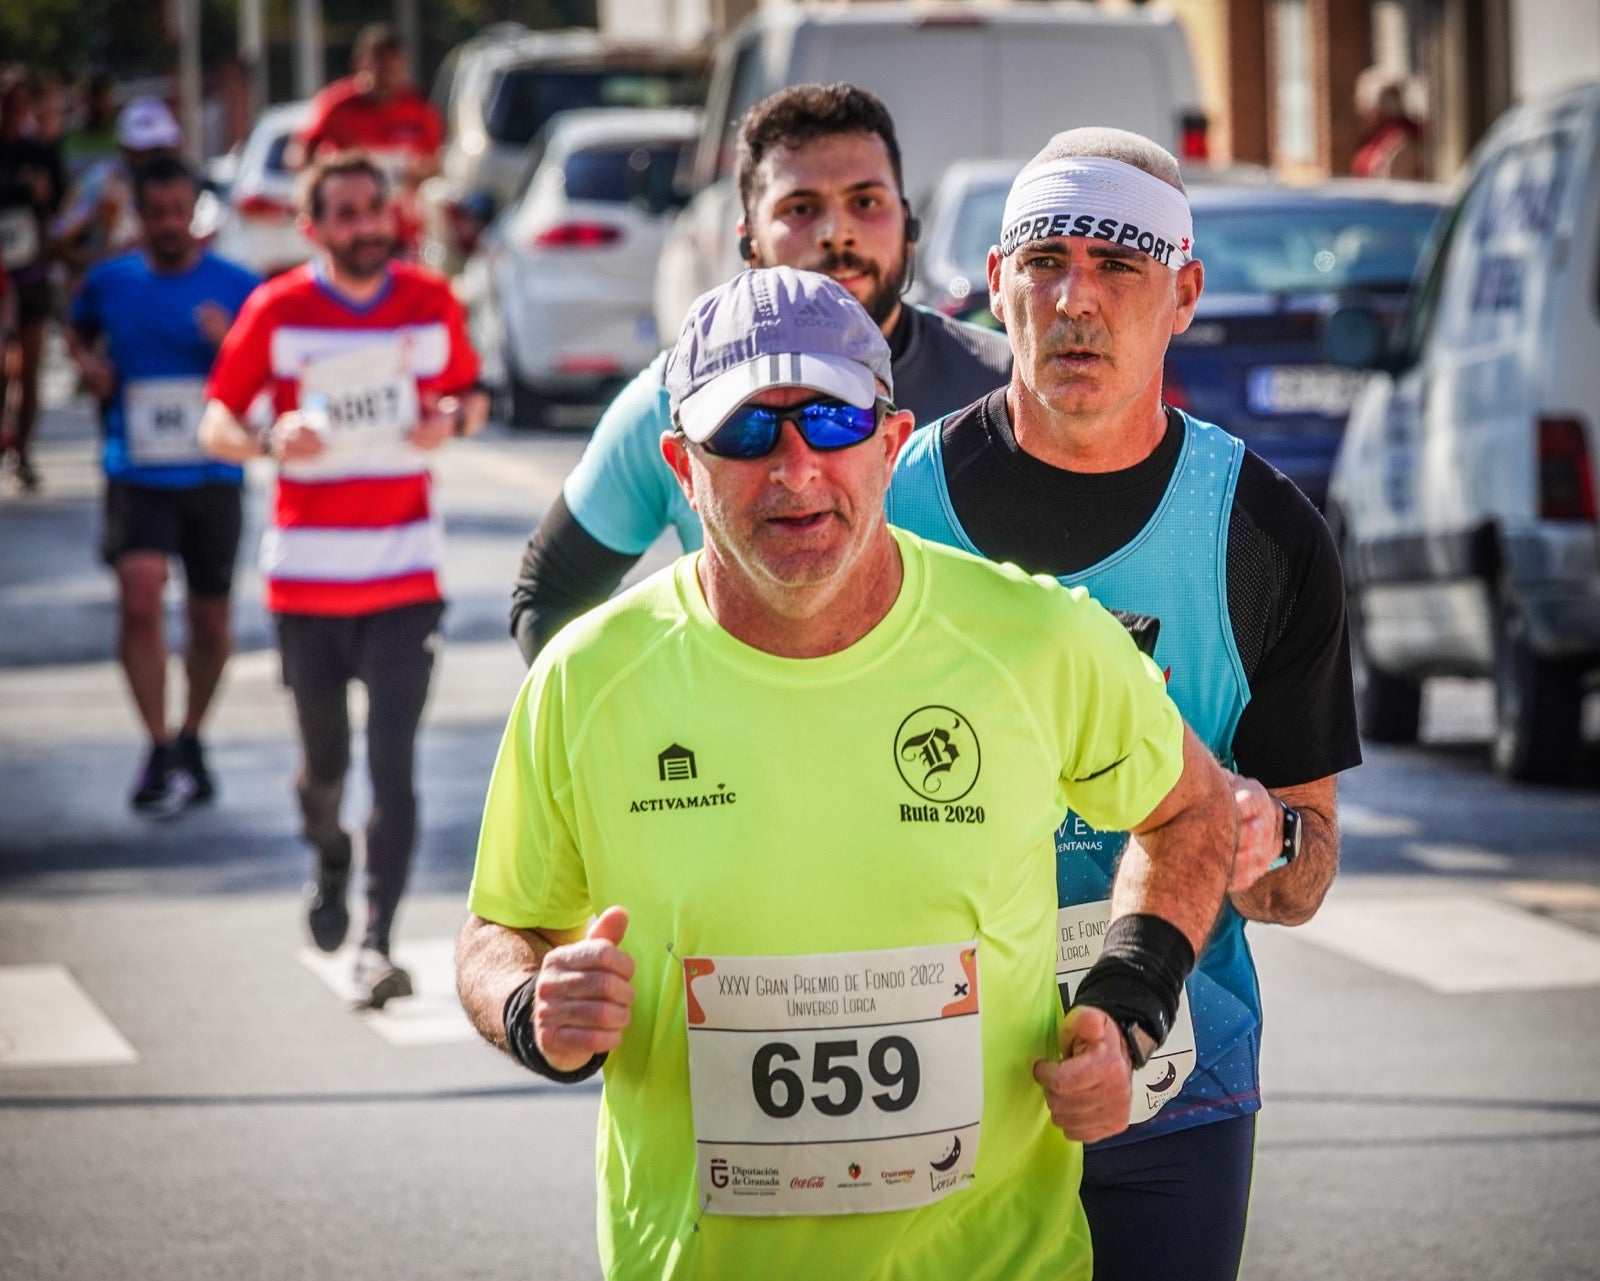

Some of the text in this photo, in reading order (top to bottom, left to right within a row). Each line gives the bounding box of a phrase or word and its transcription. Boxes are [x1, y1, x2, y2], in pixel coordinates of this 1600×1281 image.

[630, 792, 736, 813] ACTIVAMATIC
[900, 803, 985, 824] Ruta 2020
[1061, 926, 1075, 942] DE
[1061, 944, 1090, 961] LORCA
[718, 963, 944, 996] XXXV GRAN PREMIO DE FONDO 2022
[787, 997, 876, 1017] UNIVERSO LORCA
[752, 1035, 920, 1118] 659
[732, 1165, 779, 1177] Diputación
[732, 1177, 780, 1186] de Granada
